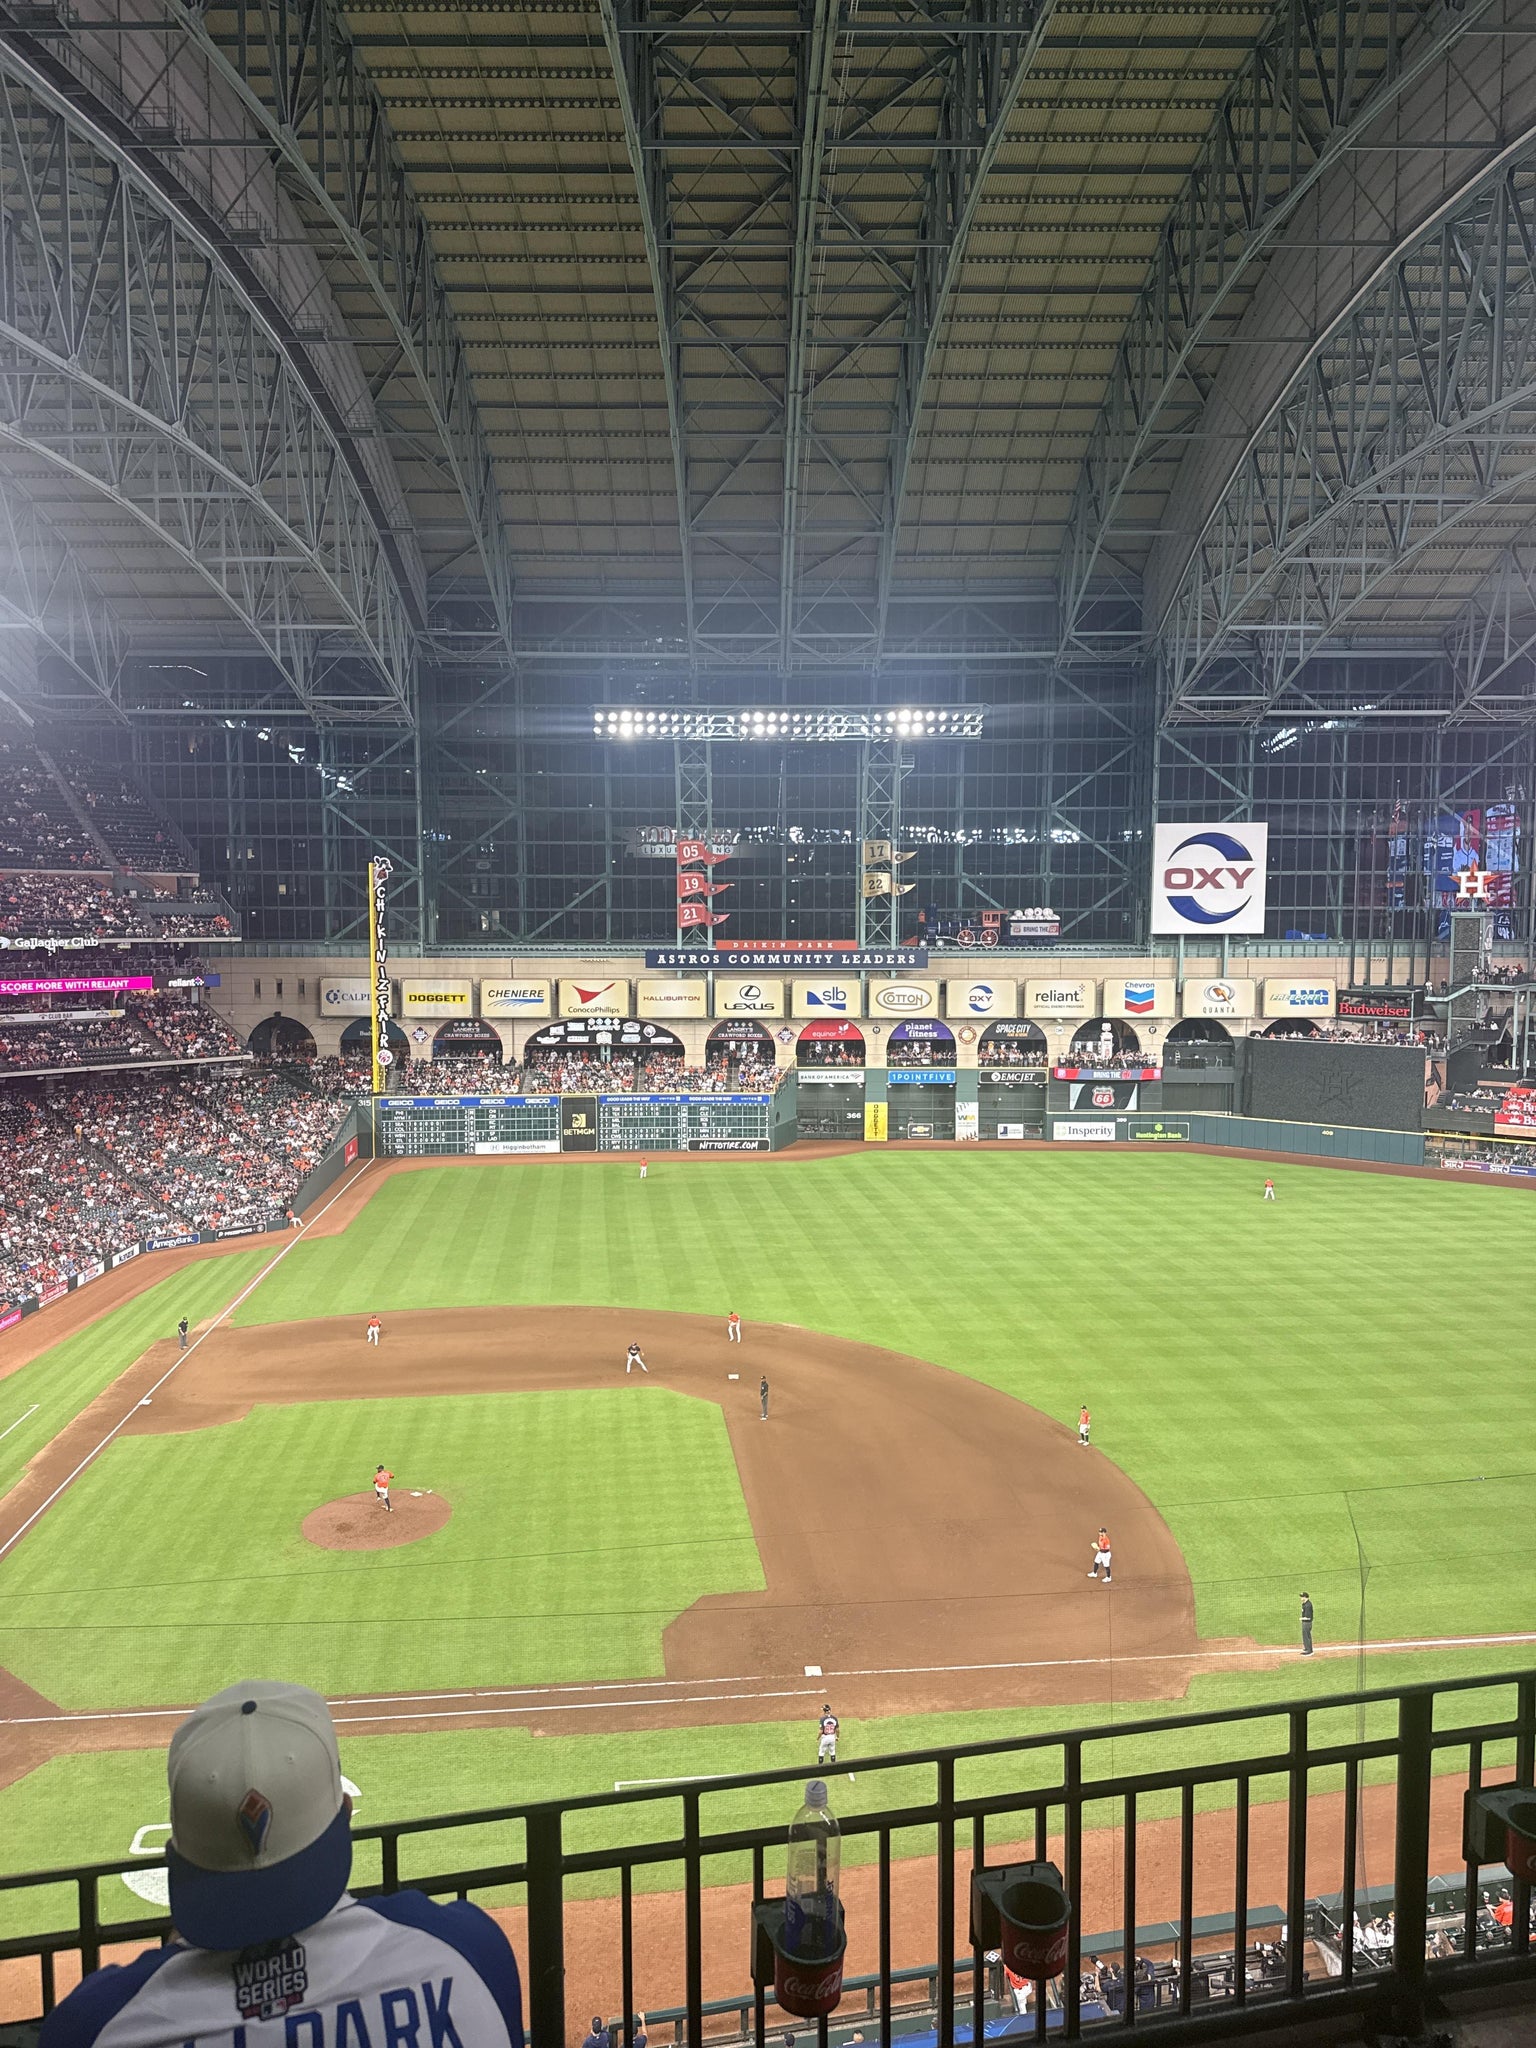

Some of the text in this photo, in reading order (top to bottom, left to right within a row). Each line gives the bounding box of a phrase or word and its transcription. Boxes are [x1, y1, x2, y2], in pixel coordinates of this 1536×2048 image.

[683, 846, 698, 858] 05
[870, 846, 884, 858] 17
[684, 878, 698, 890] 19
[869, 879, 883, 890] 22
[1164, 868, 1256, 890] OXY
[684, 908, 698, 920] 21
[376, 886, 387, 963] CHIKIN
[15, 937, 99, 950] Gallagher Club
[658, 954, 916, 964] ASTROS COMMUNITY LEADERS
[1, 980, 129, 991] SCORE MORE WITH RELIANT
[168, 979, 194, 987] reliant
[342, 993, 371, 1001] CALPI
[409, 994, 465, 1002] DOGGETT
[488, 990, 544, 998] CHENIERE
[822, 986, 846, 1001] slb
[883, 992, 923, 1006] COTTON
[1035, 990, 1080, 1002] reliant
[1290, 990, 1329, 1005] LNG
[568, 1006, 620, 1014] ConocoPhillips
[1203, 1006, 1236, 1014] QUANTA
[1338, 1002, 1410, 1017] Budweiser
[905, 1023, 932, 1032] planet
[996, 1024, 1031, 1033] SPACE CITY
[908, 1030, 938, 1038] fitness
[1001, 1073, 1036, 1081] EMCJET
[564, 1128, 595, 1136] BETMGM
[1068, 1126, 1113, 1136] Insperity
[699, 1141, 758, 1149] NITTOTIRE.COM
[153, 1235, 193, 1250] AmegyBank
[234, 1949, 304, 1986] WORLD
[238, 1972, 306, 2008] SERIES
